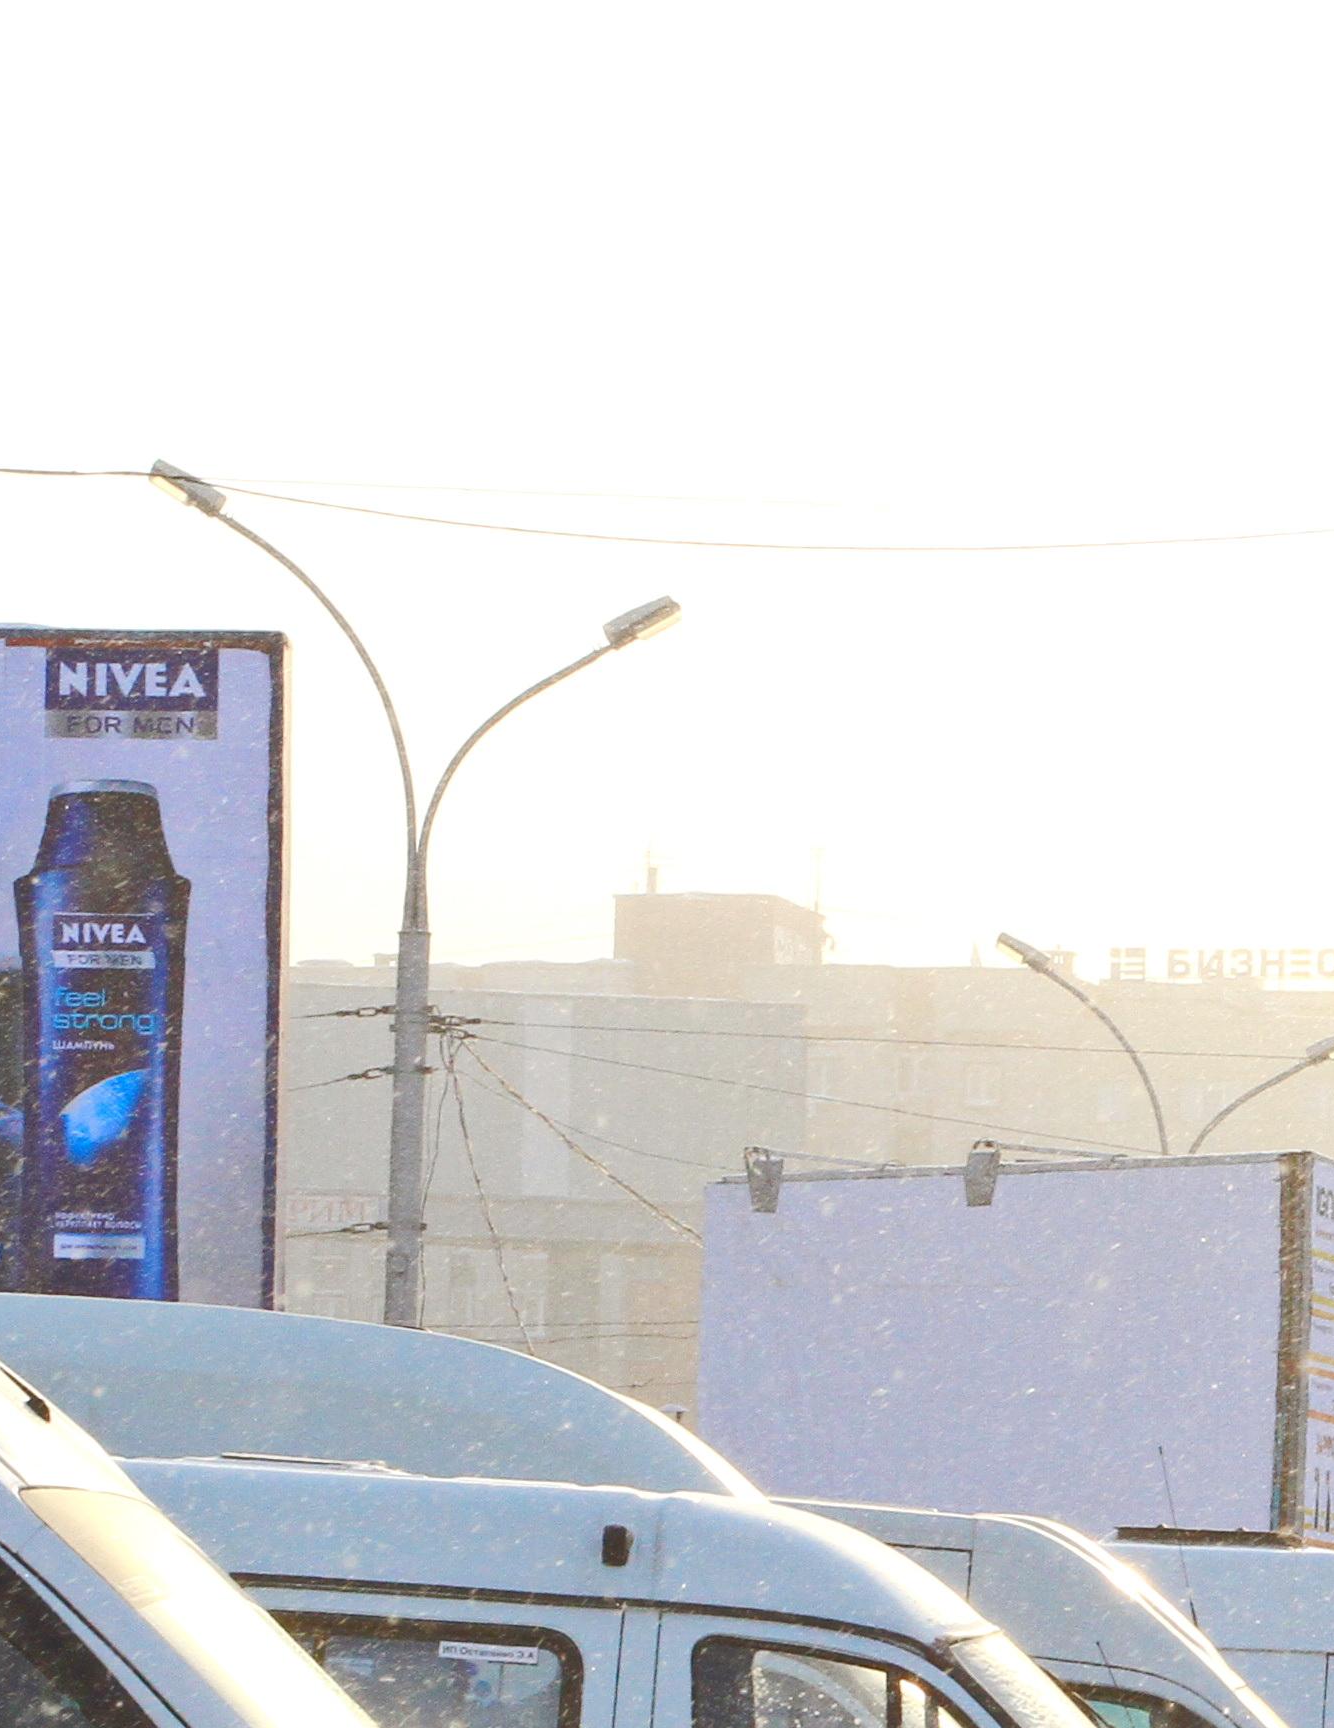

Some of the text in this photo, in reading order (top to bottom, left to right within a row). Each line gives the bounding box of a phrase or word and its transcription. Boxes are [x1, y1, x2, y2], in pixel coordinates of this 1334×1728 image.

[59, 661, 206, 697] NIVEA
[67, 716, 194, 734] FOR MEN
[62, 923, 146, 944] NIVEA
[54, 1013, 155, 1035] strong
